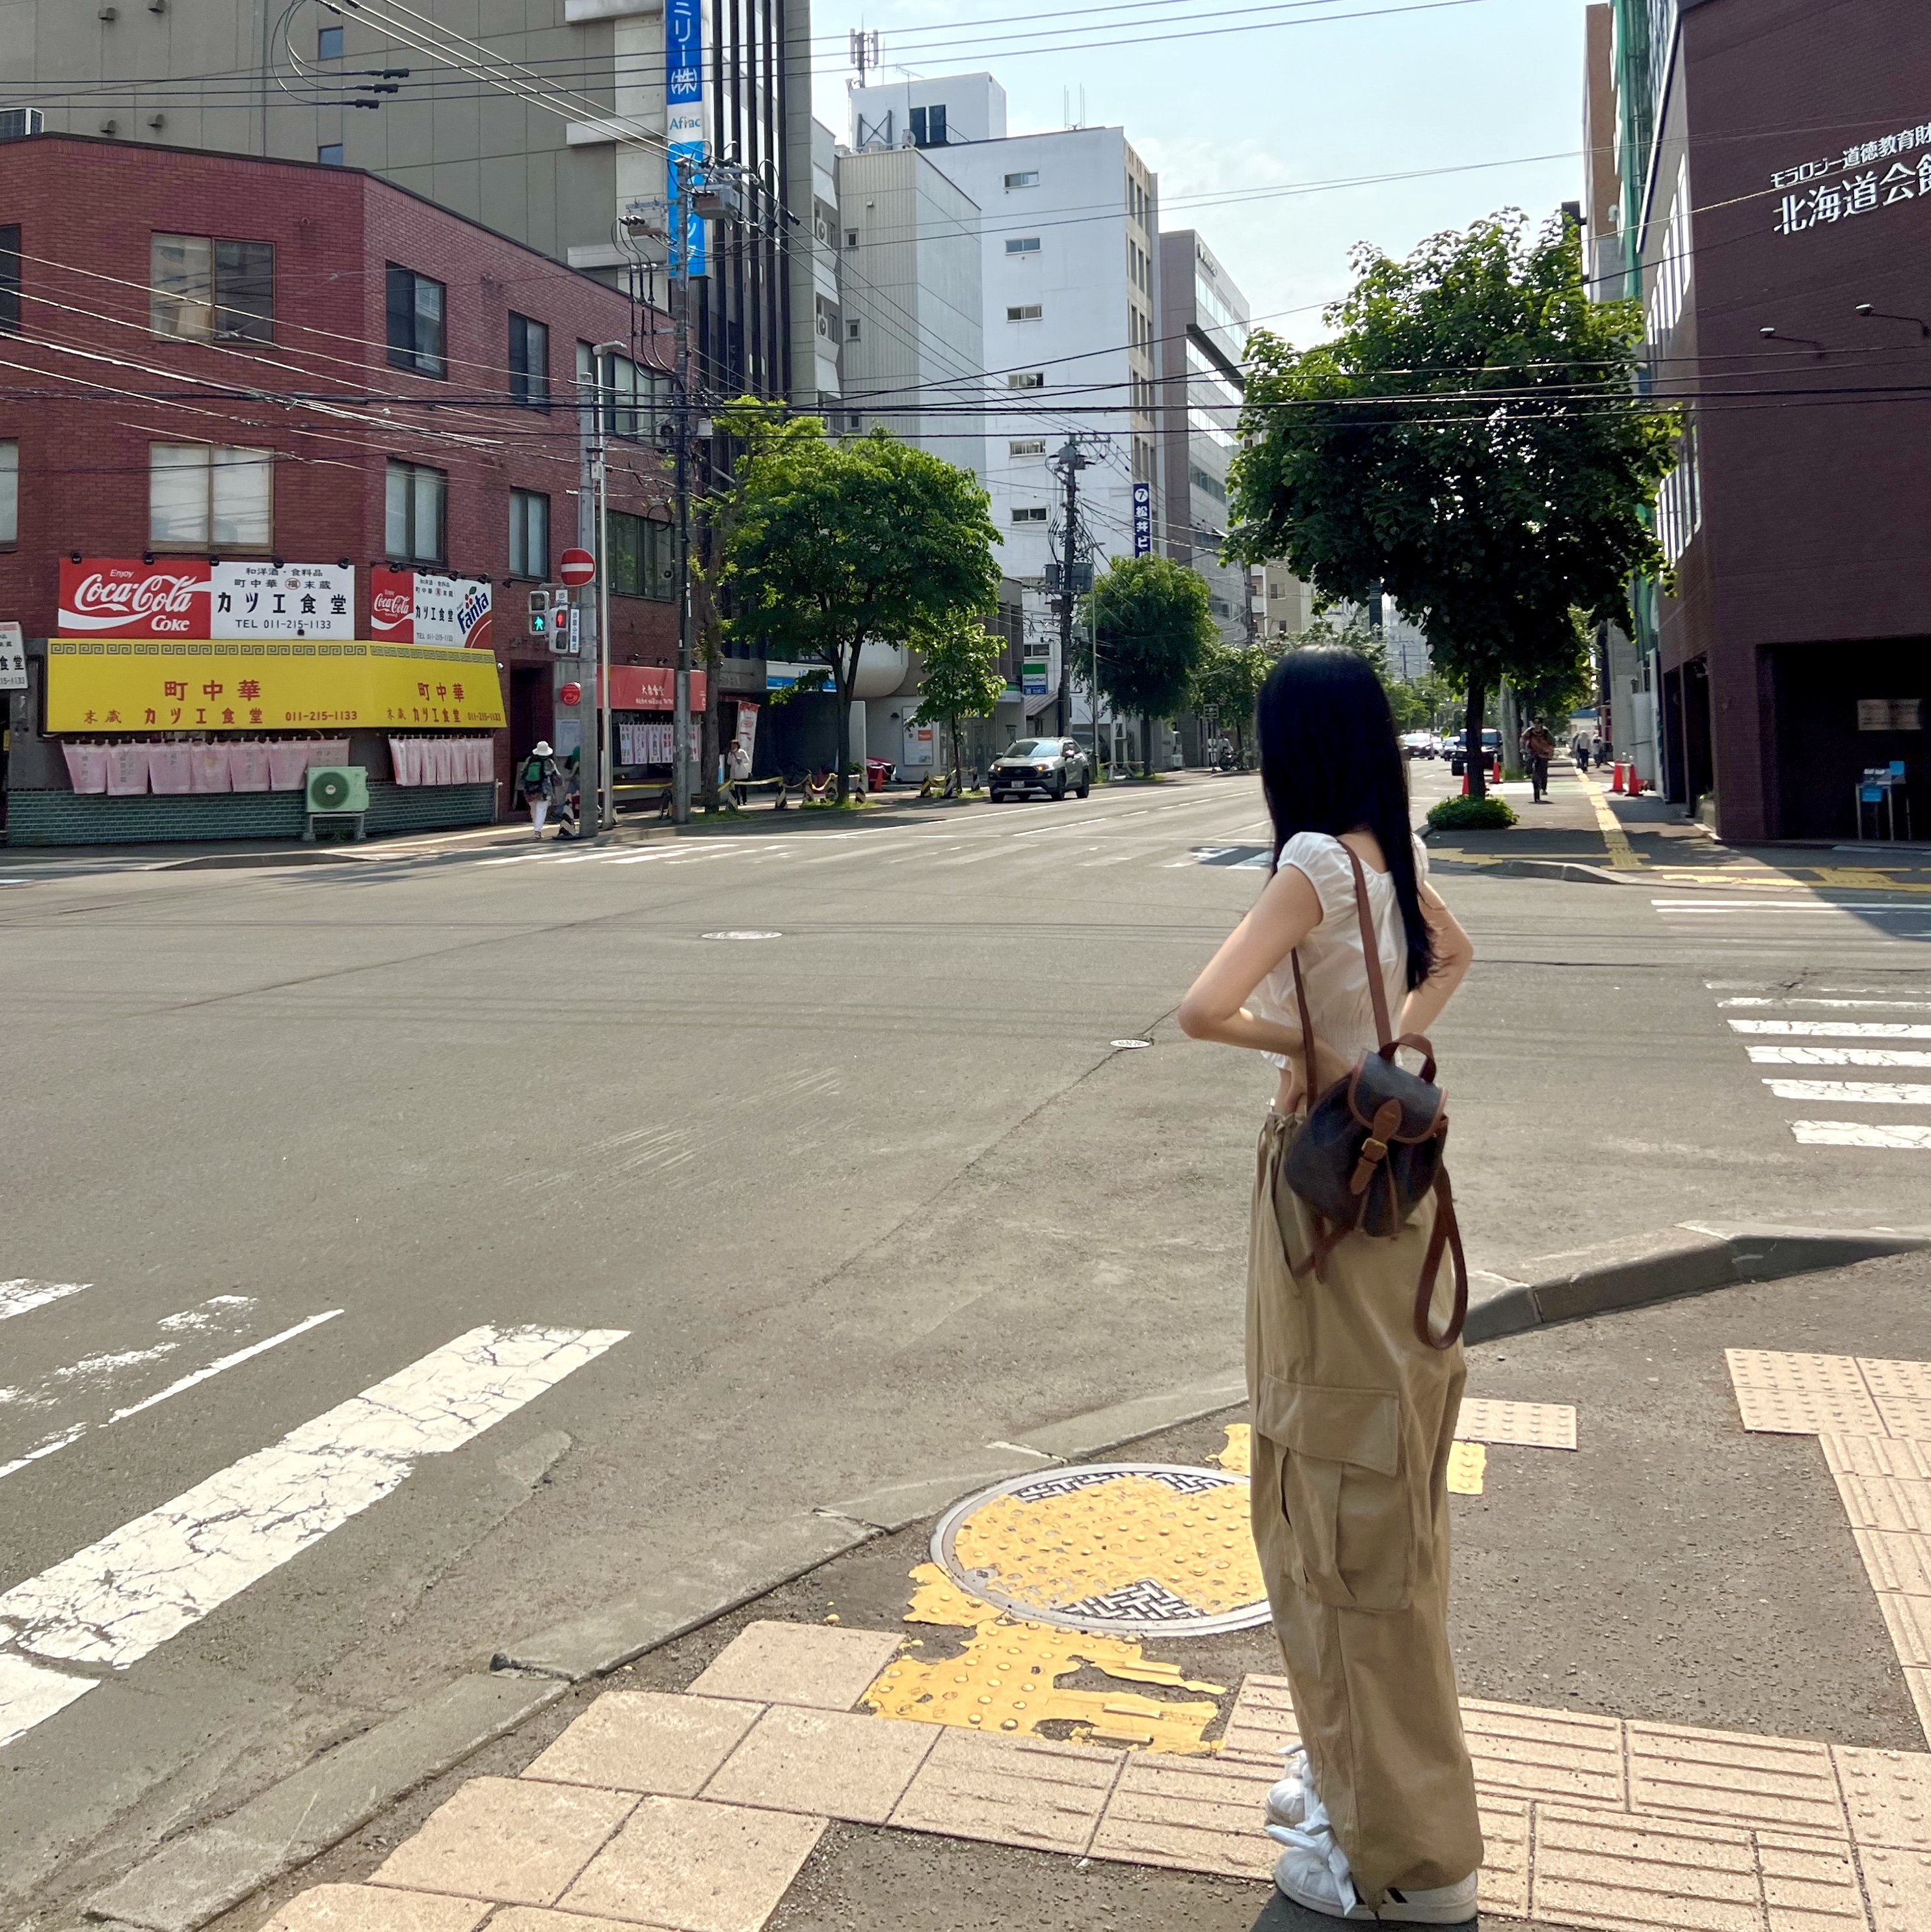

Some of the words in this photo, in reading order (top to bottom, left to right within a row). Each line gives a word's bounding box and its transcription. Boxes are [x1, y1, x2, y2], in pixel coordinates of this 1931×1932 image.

[110, 569, 133, 578] Enjoy
[234, 578, 278, 589] 町中華
[75, 573, 196, 613] Coca-Cola
[457, 592, 489, 635] Fanta
[151, 615, 190, 631] Coke
[235, 619, 258, 628] TEL
[263, 619, 332, 629] 011-215-1133
[165, 679, 261, 702] 町中華
[417, 682, 465, 702] 町中華
[285, 710, 358, 721] 011-215-1133
